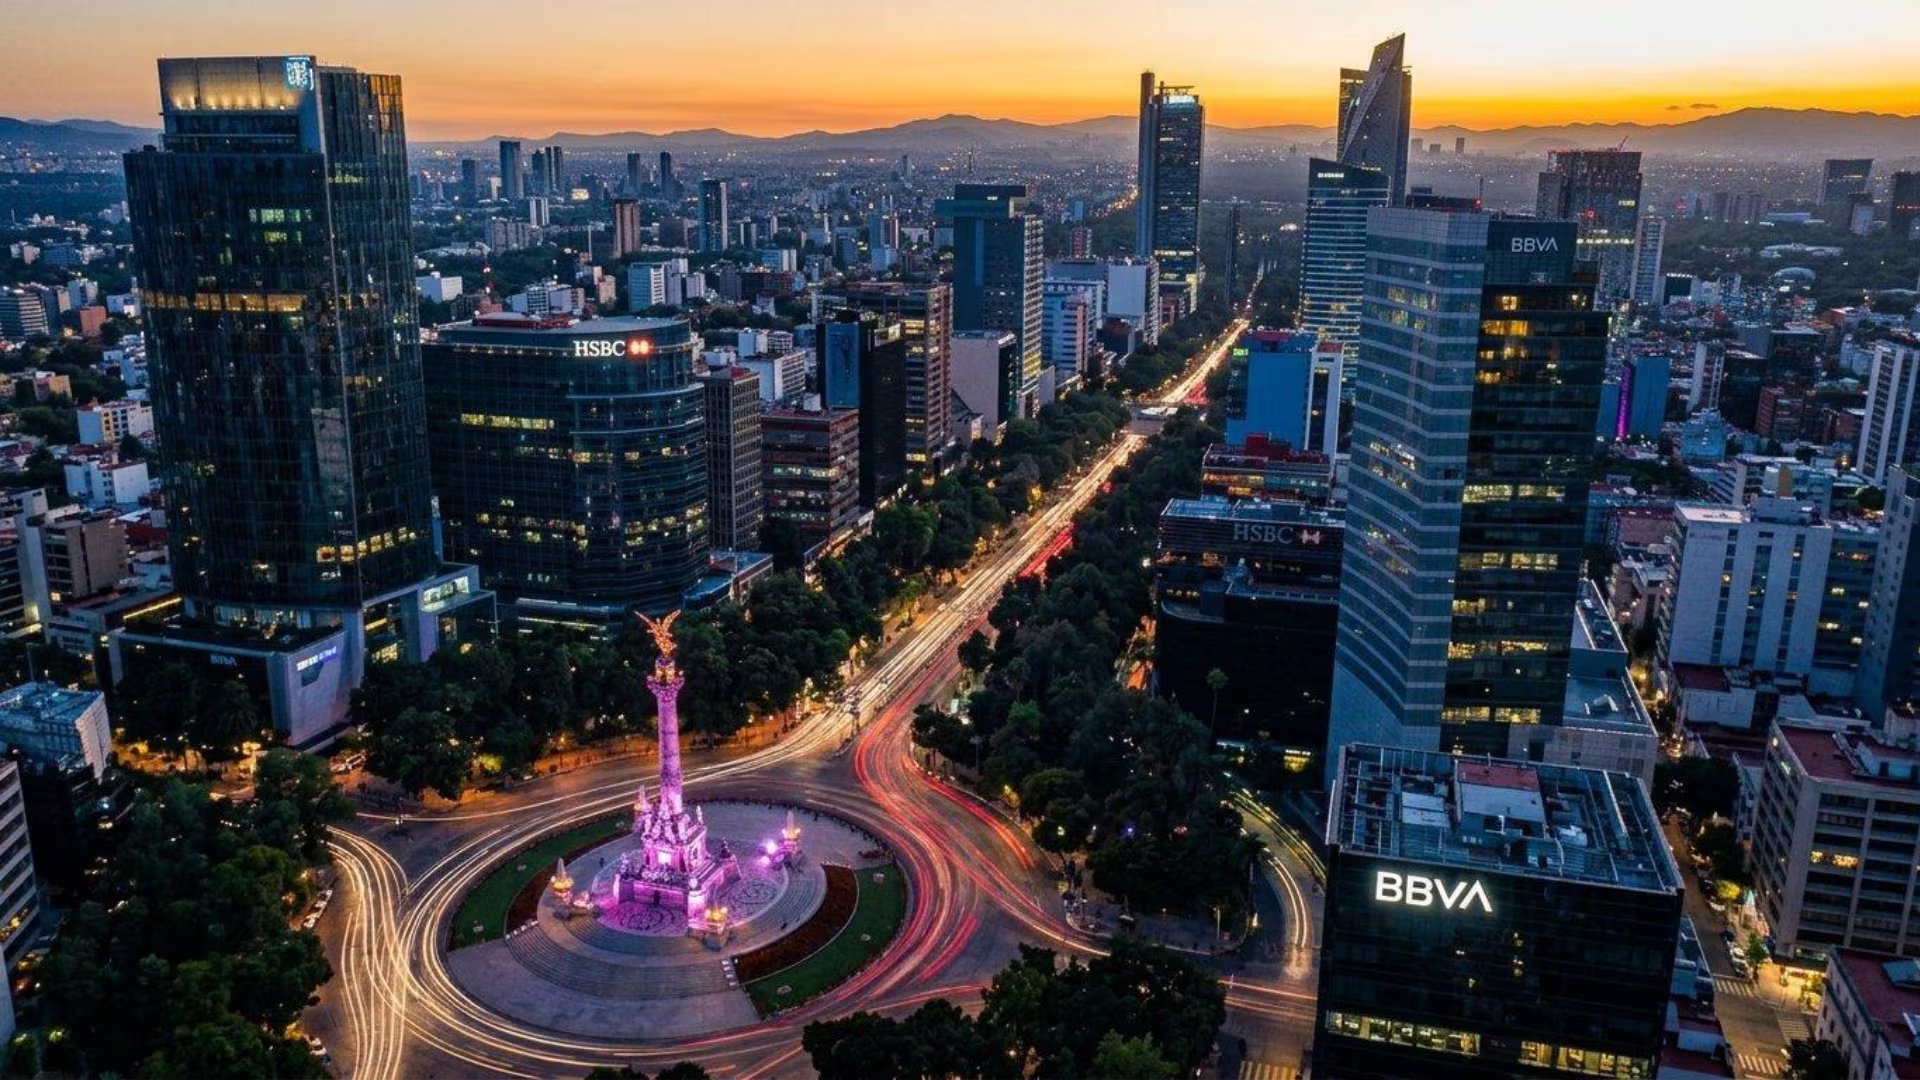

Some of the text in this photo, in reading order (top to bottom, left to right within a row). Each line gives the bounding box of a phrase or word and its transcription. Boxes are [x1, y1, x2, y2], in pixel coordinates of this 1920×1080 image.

[1511, 237, 1559, 253] BBVA
[573, 339, 626, 357] HSBC
[1233, 522, 1294, 544] HSBC
[1375, 871, 1494, 913] BBVA
